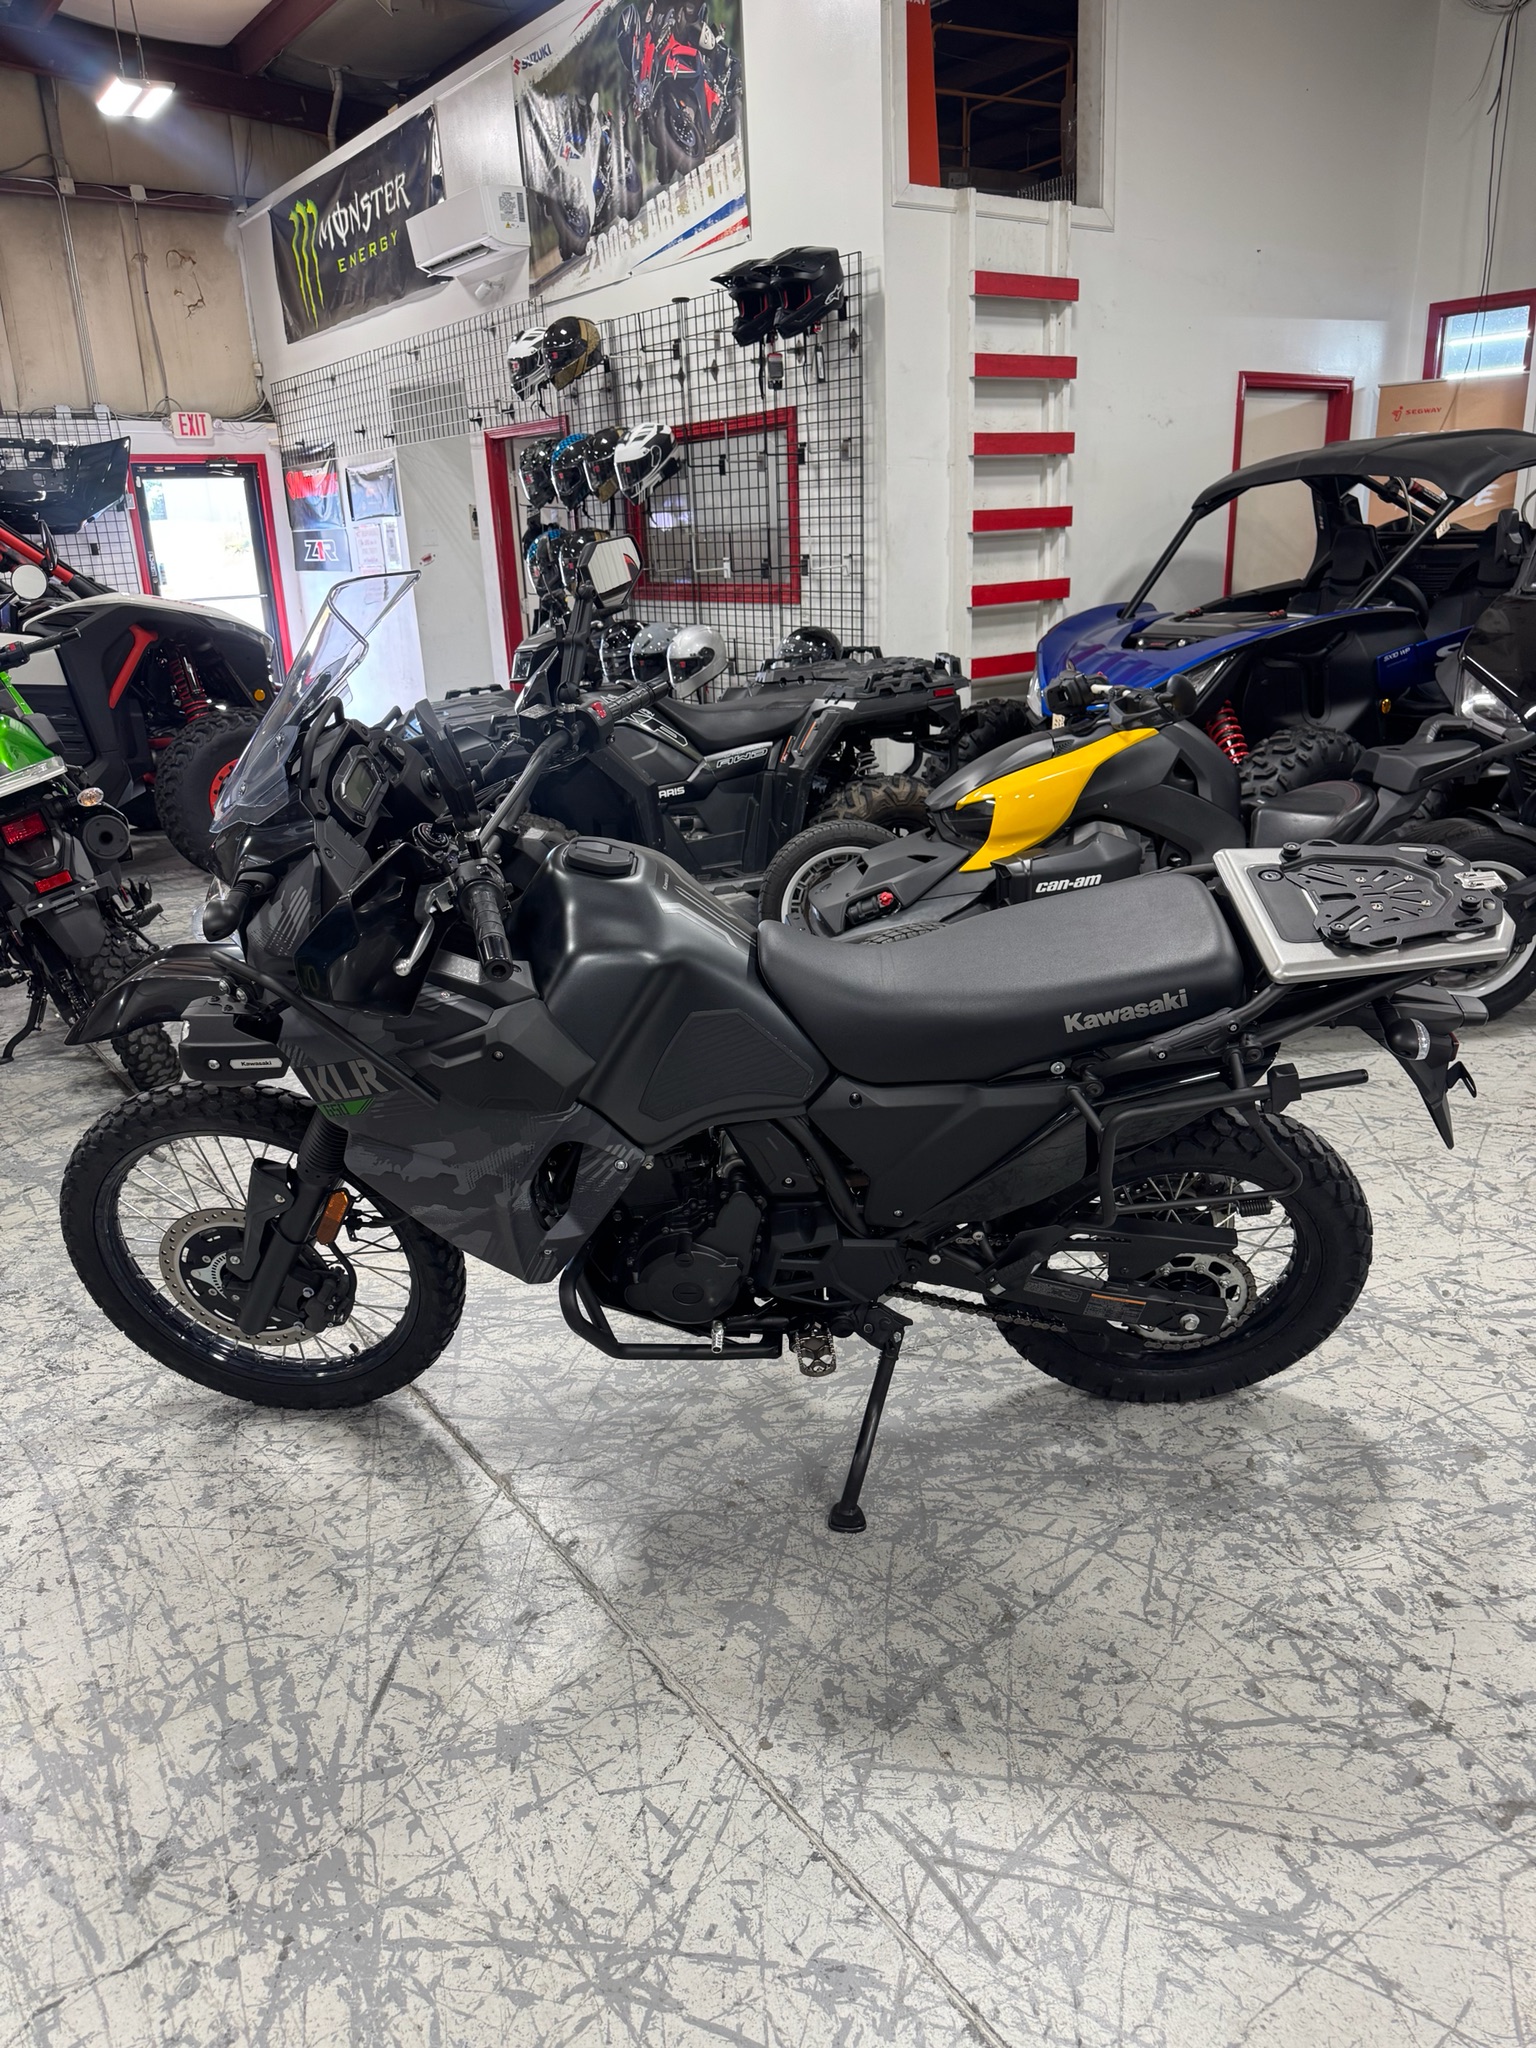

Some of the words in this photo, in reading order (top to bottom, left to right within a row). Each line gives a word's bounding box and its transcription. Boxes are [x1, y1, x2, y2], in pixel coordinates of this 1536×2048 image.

[521, 43, 552, 70] SUZUKI
[318, 172, 411, 250] MONSTER
[337, 230, 398, 273] ENERGY
[178, 413, 206, 436] EXIT
[1405, 406, 1442, 416] SEGWAY
[1035, 873, 1102, 894] can-am
[1063, 988, 1188, 1034] Kawasaki
[303, 1058, 389, 1102] KLR
